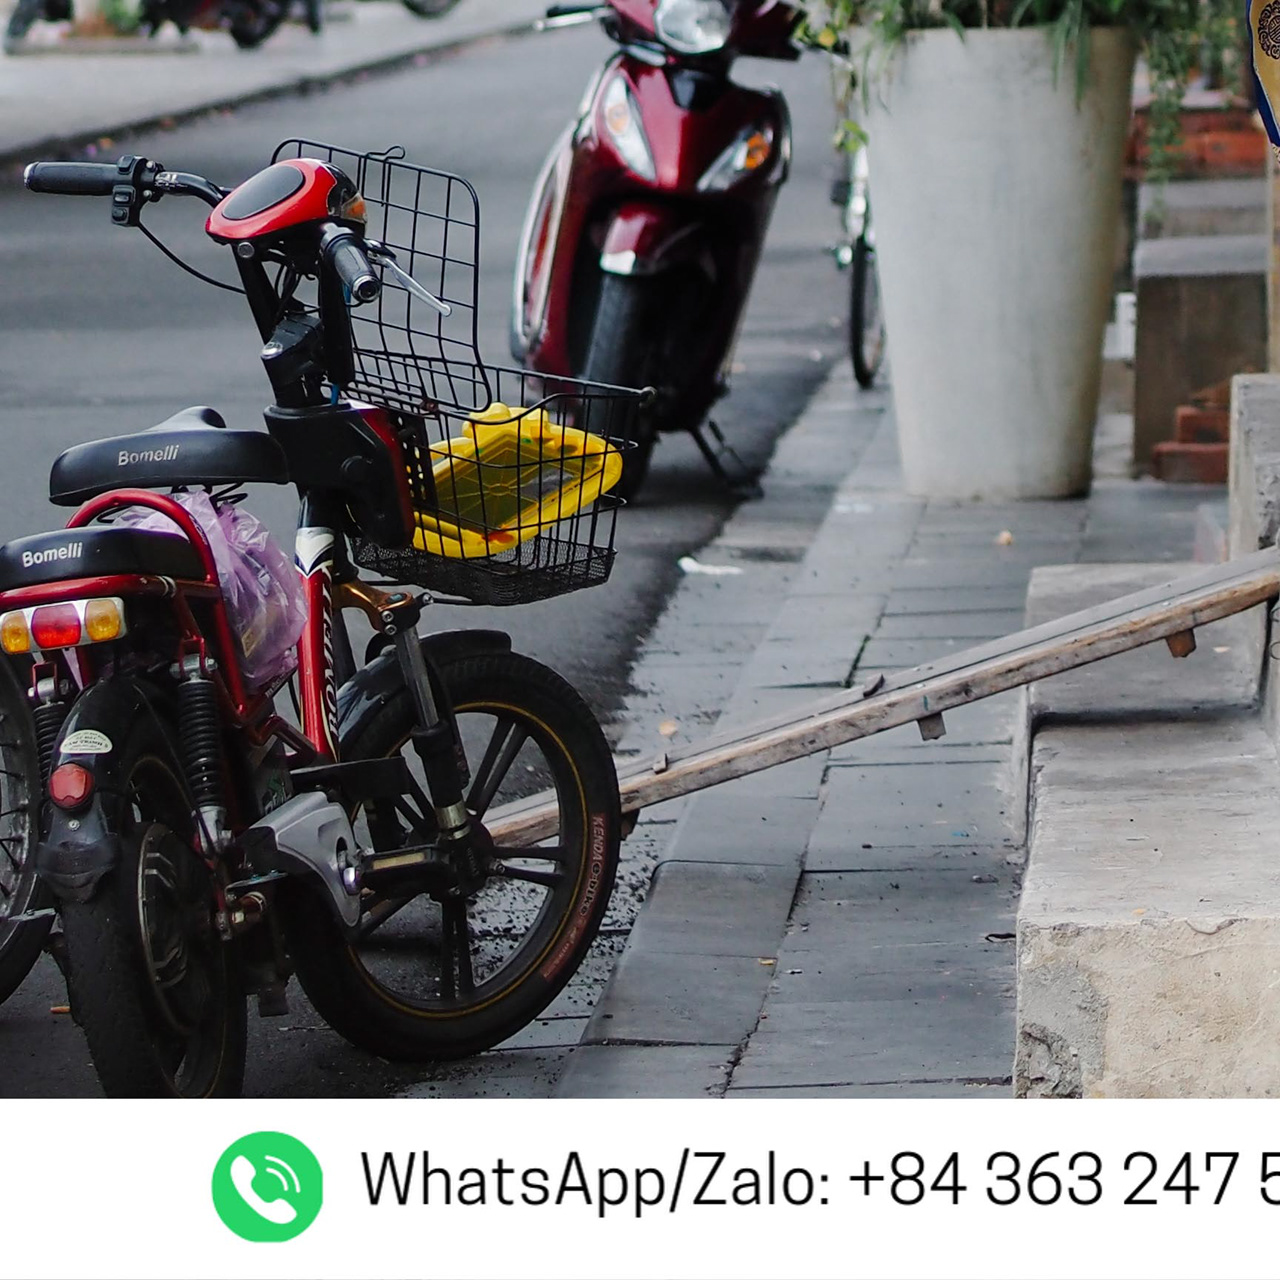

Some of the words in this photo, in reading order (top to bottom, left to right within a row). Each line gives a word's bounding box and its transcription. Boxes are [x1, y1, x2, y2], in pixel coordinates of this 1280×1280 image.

[117, 444, 180, 467] Bomelli
[22, 541, 83, 568] Bomelli
[592, 816, 605, 861] KENDA
